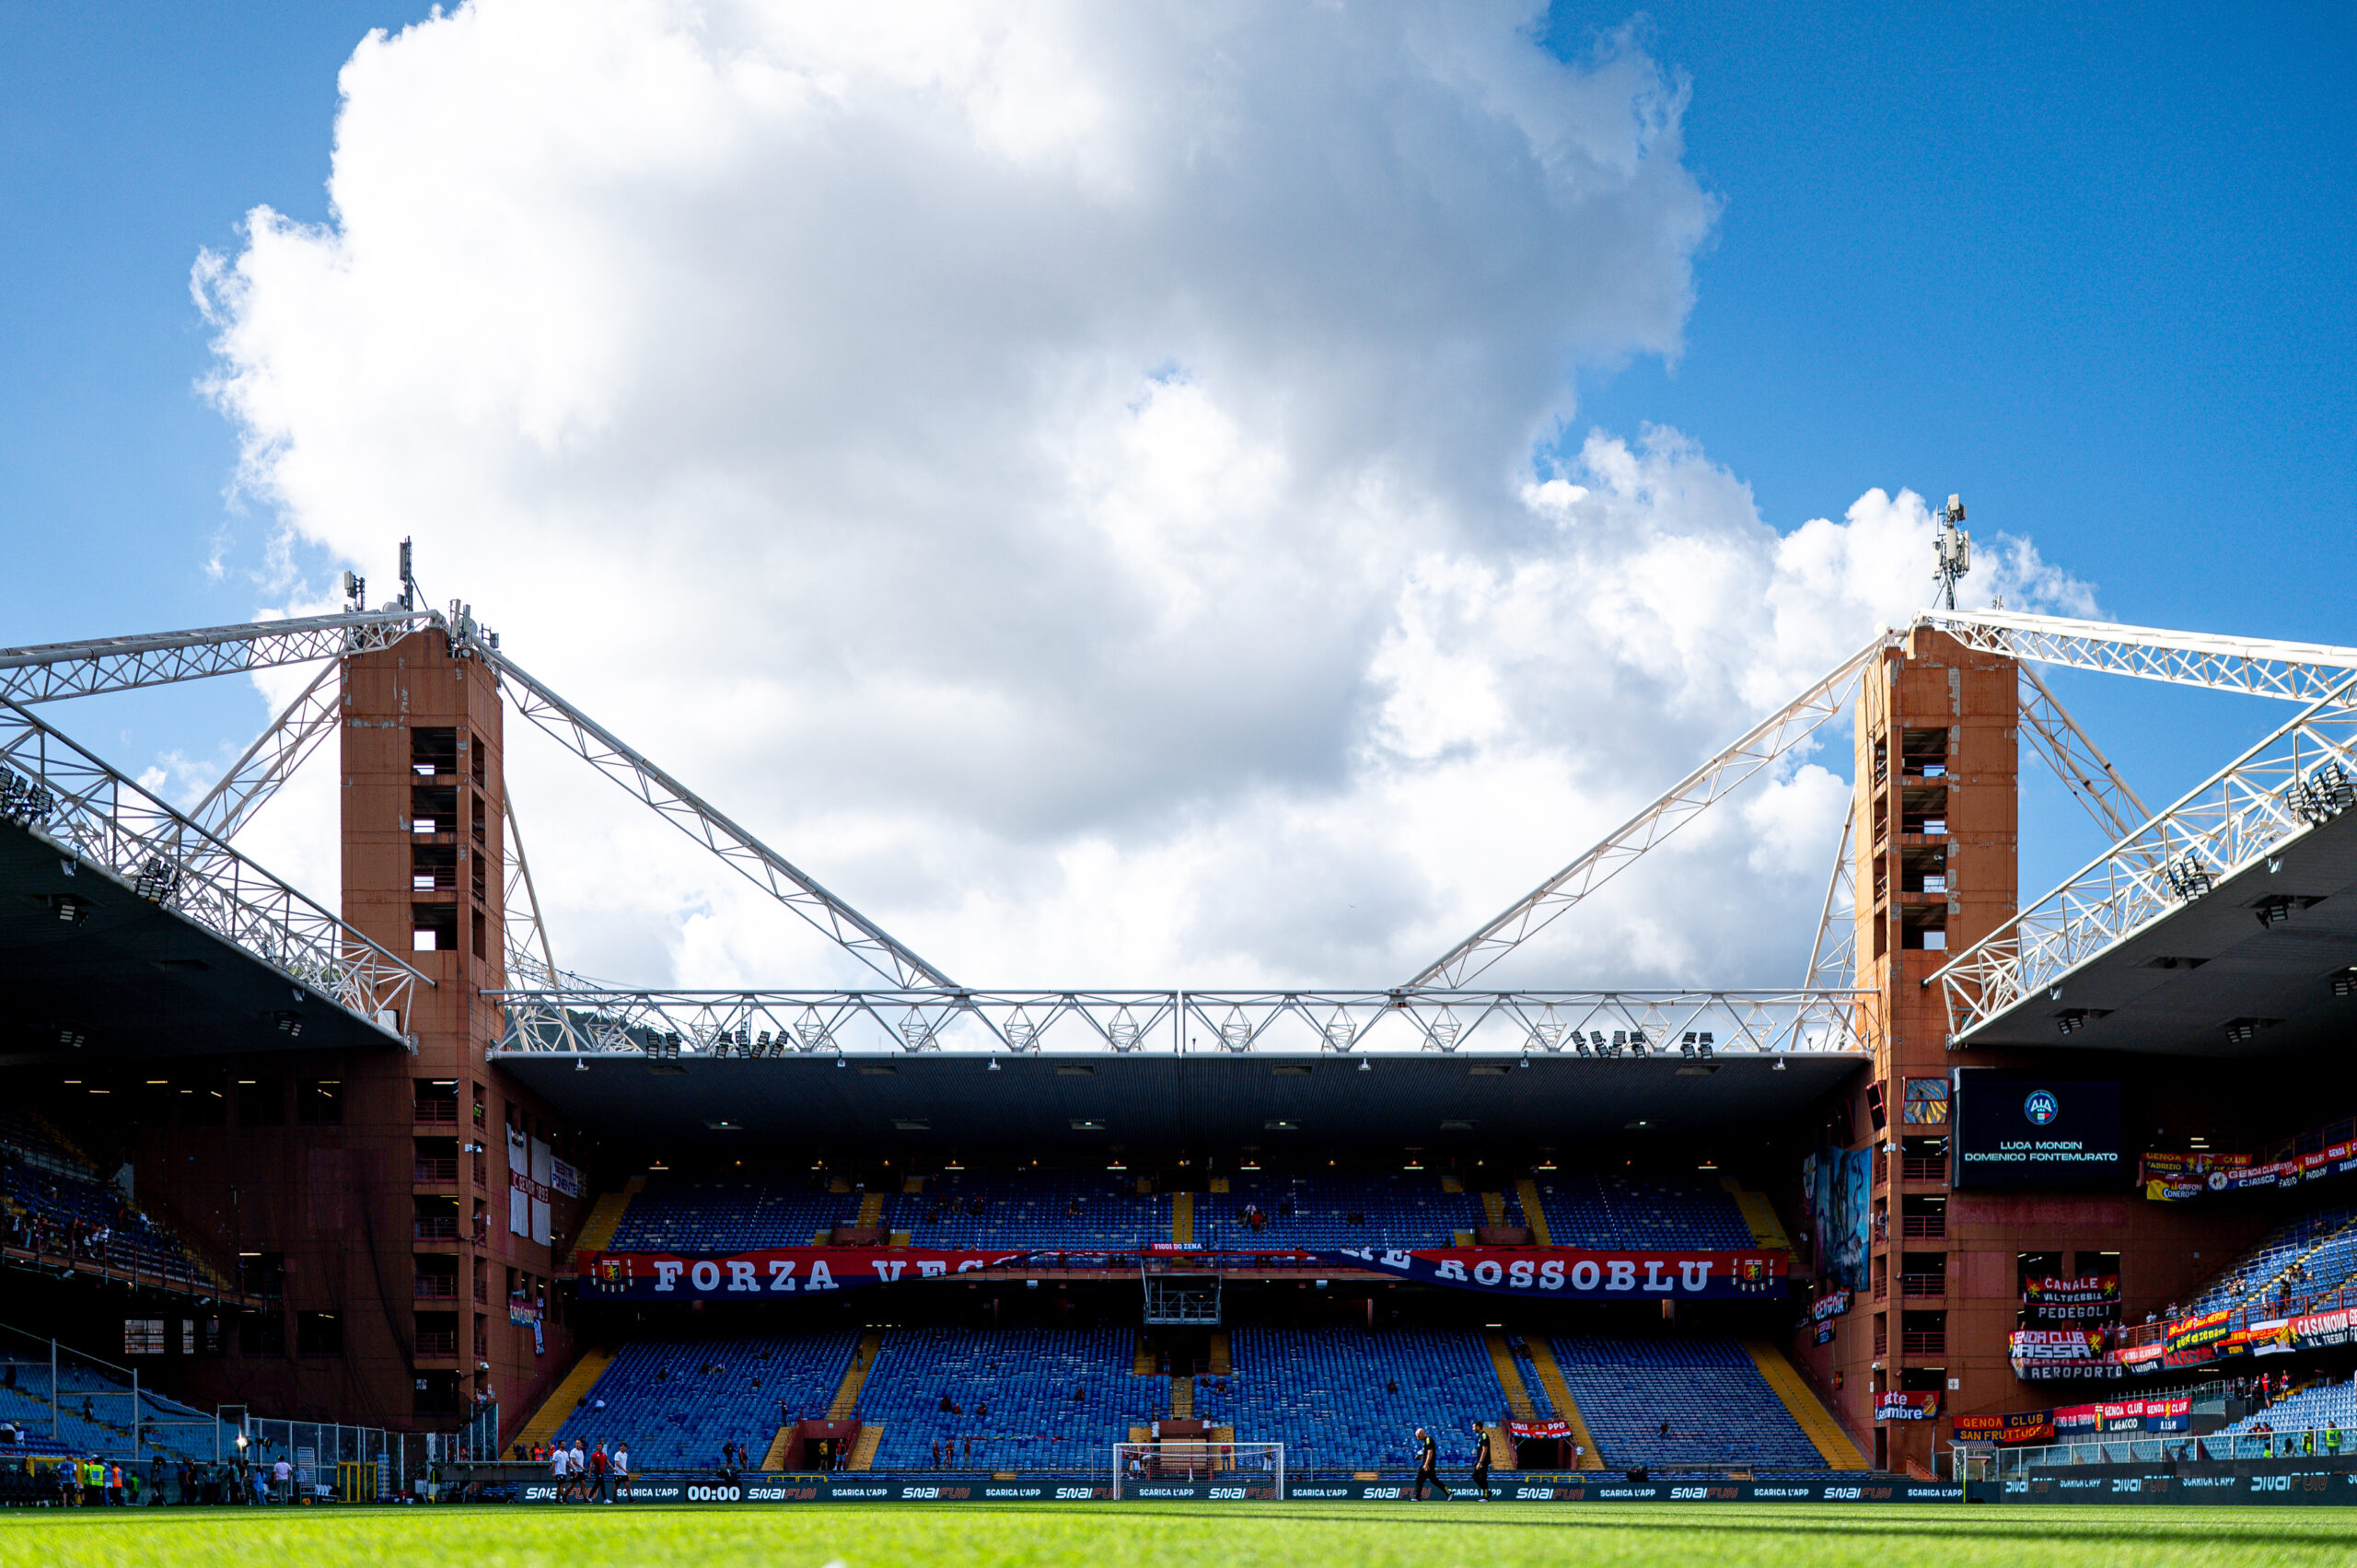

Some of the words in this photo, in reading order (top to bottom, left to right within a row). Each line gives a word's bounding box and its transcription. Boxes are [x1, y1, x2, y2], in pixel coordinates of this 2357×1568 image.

[2000, 1142, 2032, 1150] LUCA
[2036, 1142, 2083, 1150] MONDIN
[1965, 1153, 2026, 1161] DOMENICO
[2029, 1153, 2119, 1161] FONTEMURATO
[2223, 1156, 2247, 1164] CLUB
[2146, 1161, 2182, 1170] FABRIZIO
[2228, 1167, 2261, 1179] GENOA
[2262, 1163, 2280, 1175] CLUB
[654, 1260, 840, 1292] FORZA
[1434, 1260, 1713, 1292] ROSSOBLU
[2045, 1277, 2098, 1291] CANALE
[2043, 1292, 2102, 1302] VALTREBBIA
[2038, 1306, 2109, 1318] PEDEGOLI
[2297, 1313, 2349, 1337] CASANOVA
[2049, 1330, 2087, 1344] CLUB
[2012, 1344, 2092, 1358] MASSA
[2031, 1365, 2122, 1378] AEROPORTO
[2105, 1405, 2124, 1417] GENOA
[2127, 1401, 2143, 1414] CLUB
[2146, 1403, 2164, 1414] GENOA
[2171, 1401, 2188, 1413] CLUB
[1963, 1418, 2003, 1428] GENOA
[2011, 1414, 2044, 1426] CLUB
[2109, 1418, 2138, 1430] LAGACCIO
[1960, 1430, 1981, 1441] SAN
[1984, 1426, 2049, 1441] FRUTTUOSO
[655, 1488, 679, 1497] L'APP
[688, 1485, 740, 1501] 00:00
[832, 1488, 865, 1497] SCARICA
[866, 1488, 888, 1497] L'APP
[985, 1488, 1018, 1497] SCARICA
[1019, 1488, 1040, 1497] L'APP
[1139, 1488, 1172, 1497] SCARICA
[1173, 1488, 1194, 1497] L'APP
[1293, 1488, 1326, 1497] SCARICA
[1327, 1488, 1348, 1497] L'APP
[1600, 1488, 1633, 1497] SCARICA
[1634, 1488, 1655, 1497] L'APP
[1754, 1488, 1787, 1497] SCARICA
[1788, 1488, 1809, 1497] L'APP
[1908, 1488, 1941, 1497] SCARICA
[1942, 1488, 1963, 1497] L'APP
